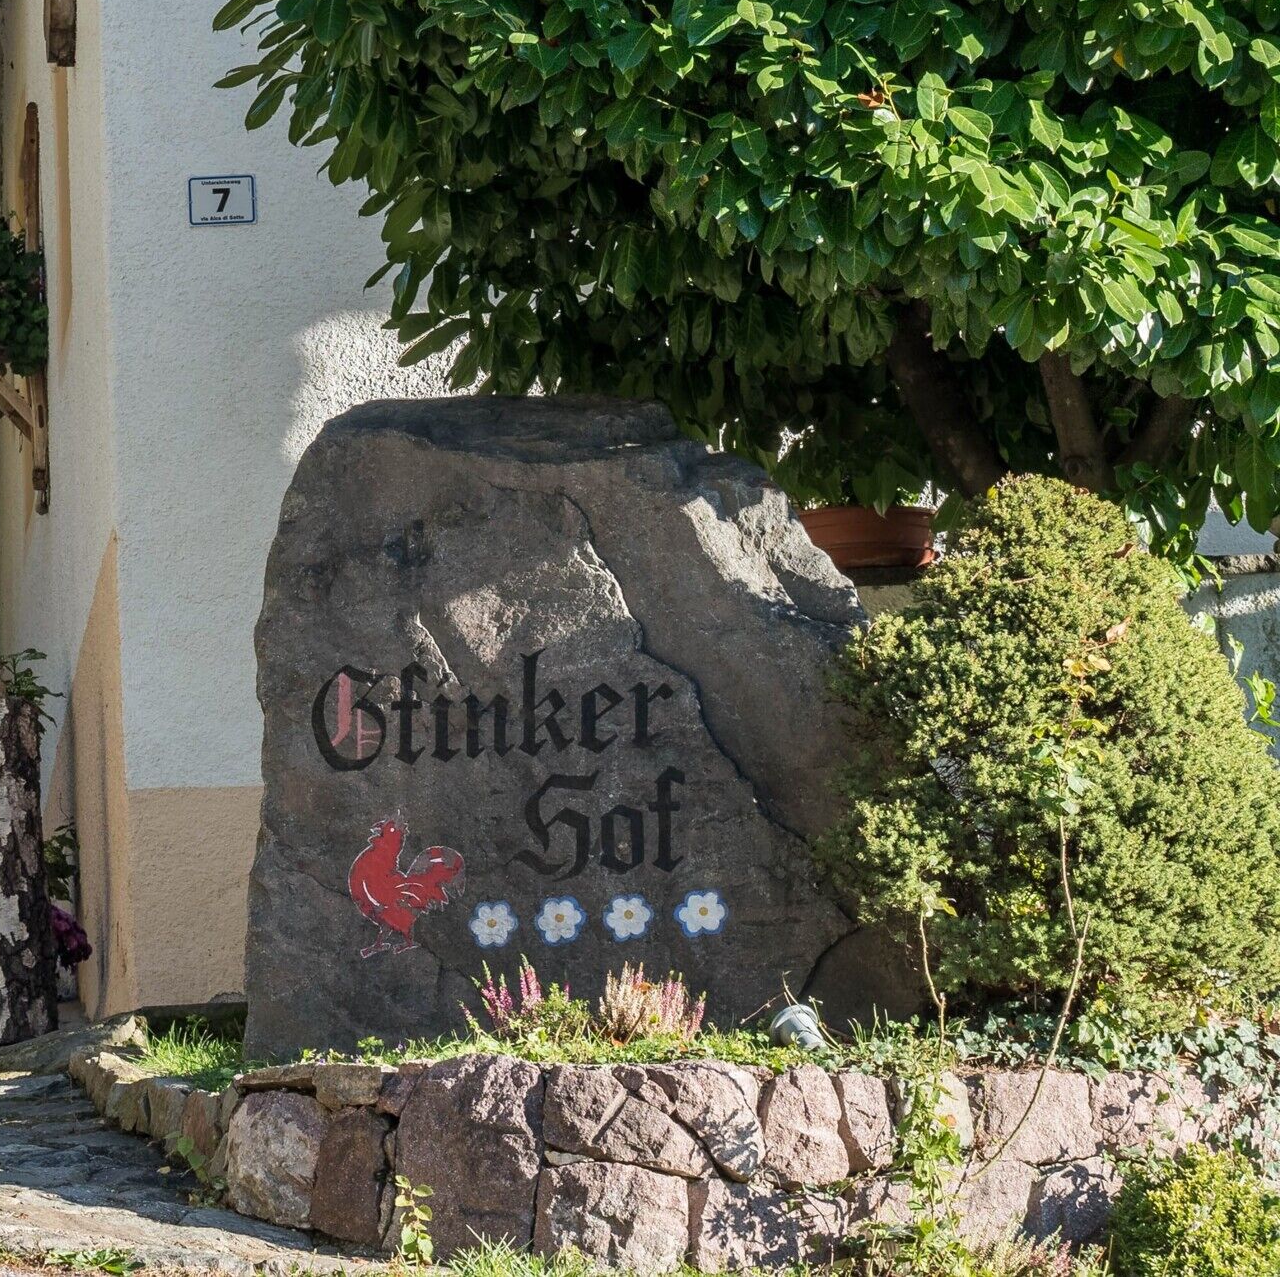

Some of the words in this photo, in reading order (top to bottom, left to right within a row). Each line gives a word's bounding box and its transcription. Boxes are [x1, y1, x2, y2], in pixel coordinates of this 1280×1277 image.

[212, 188, 230, 212] 7
[311, 648, 674, 771] Gfinker
[505, 765, 685, 882] Hof
